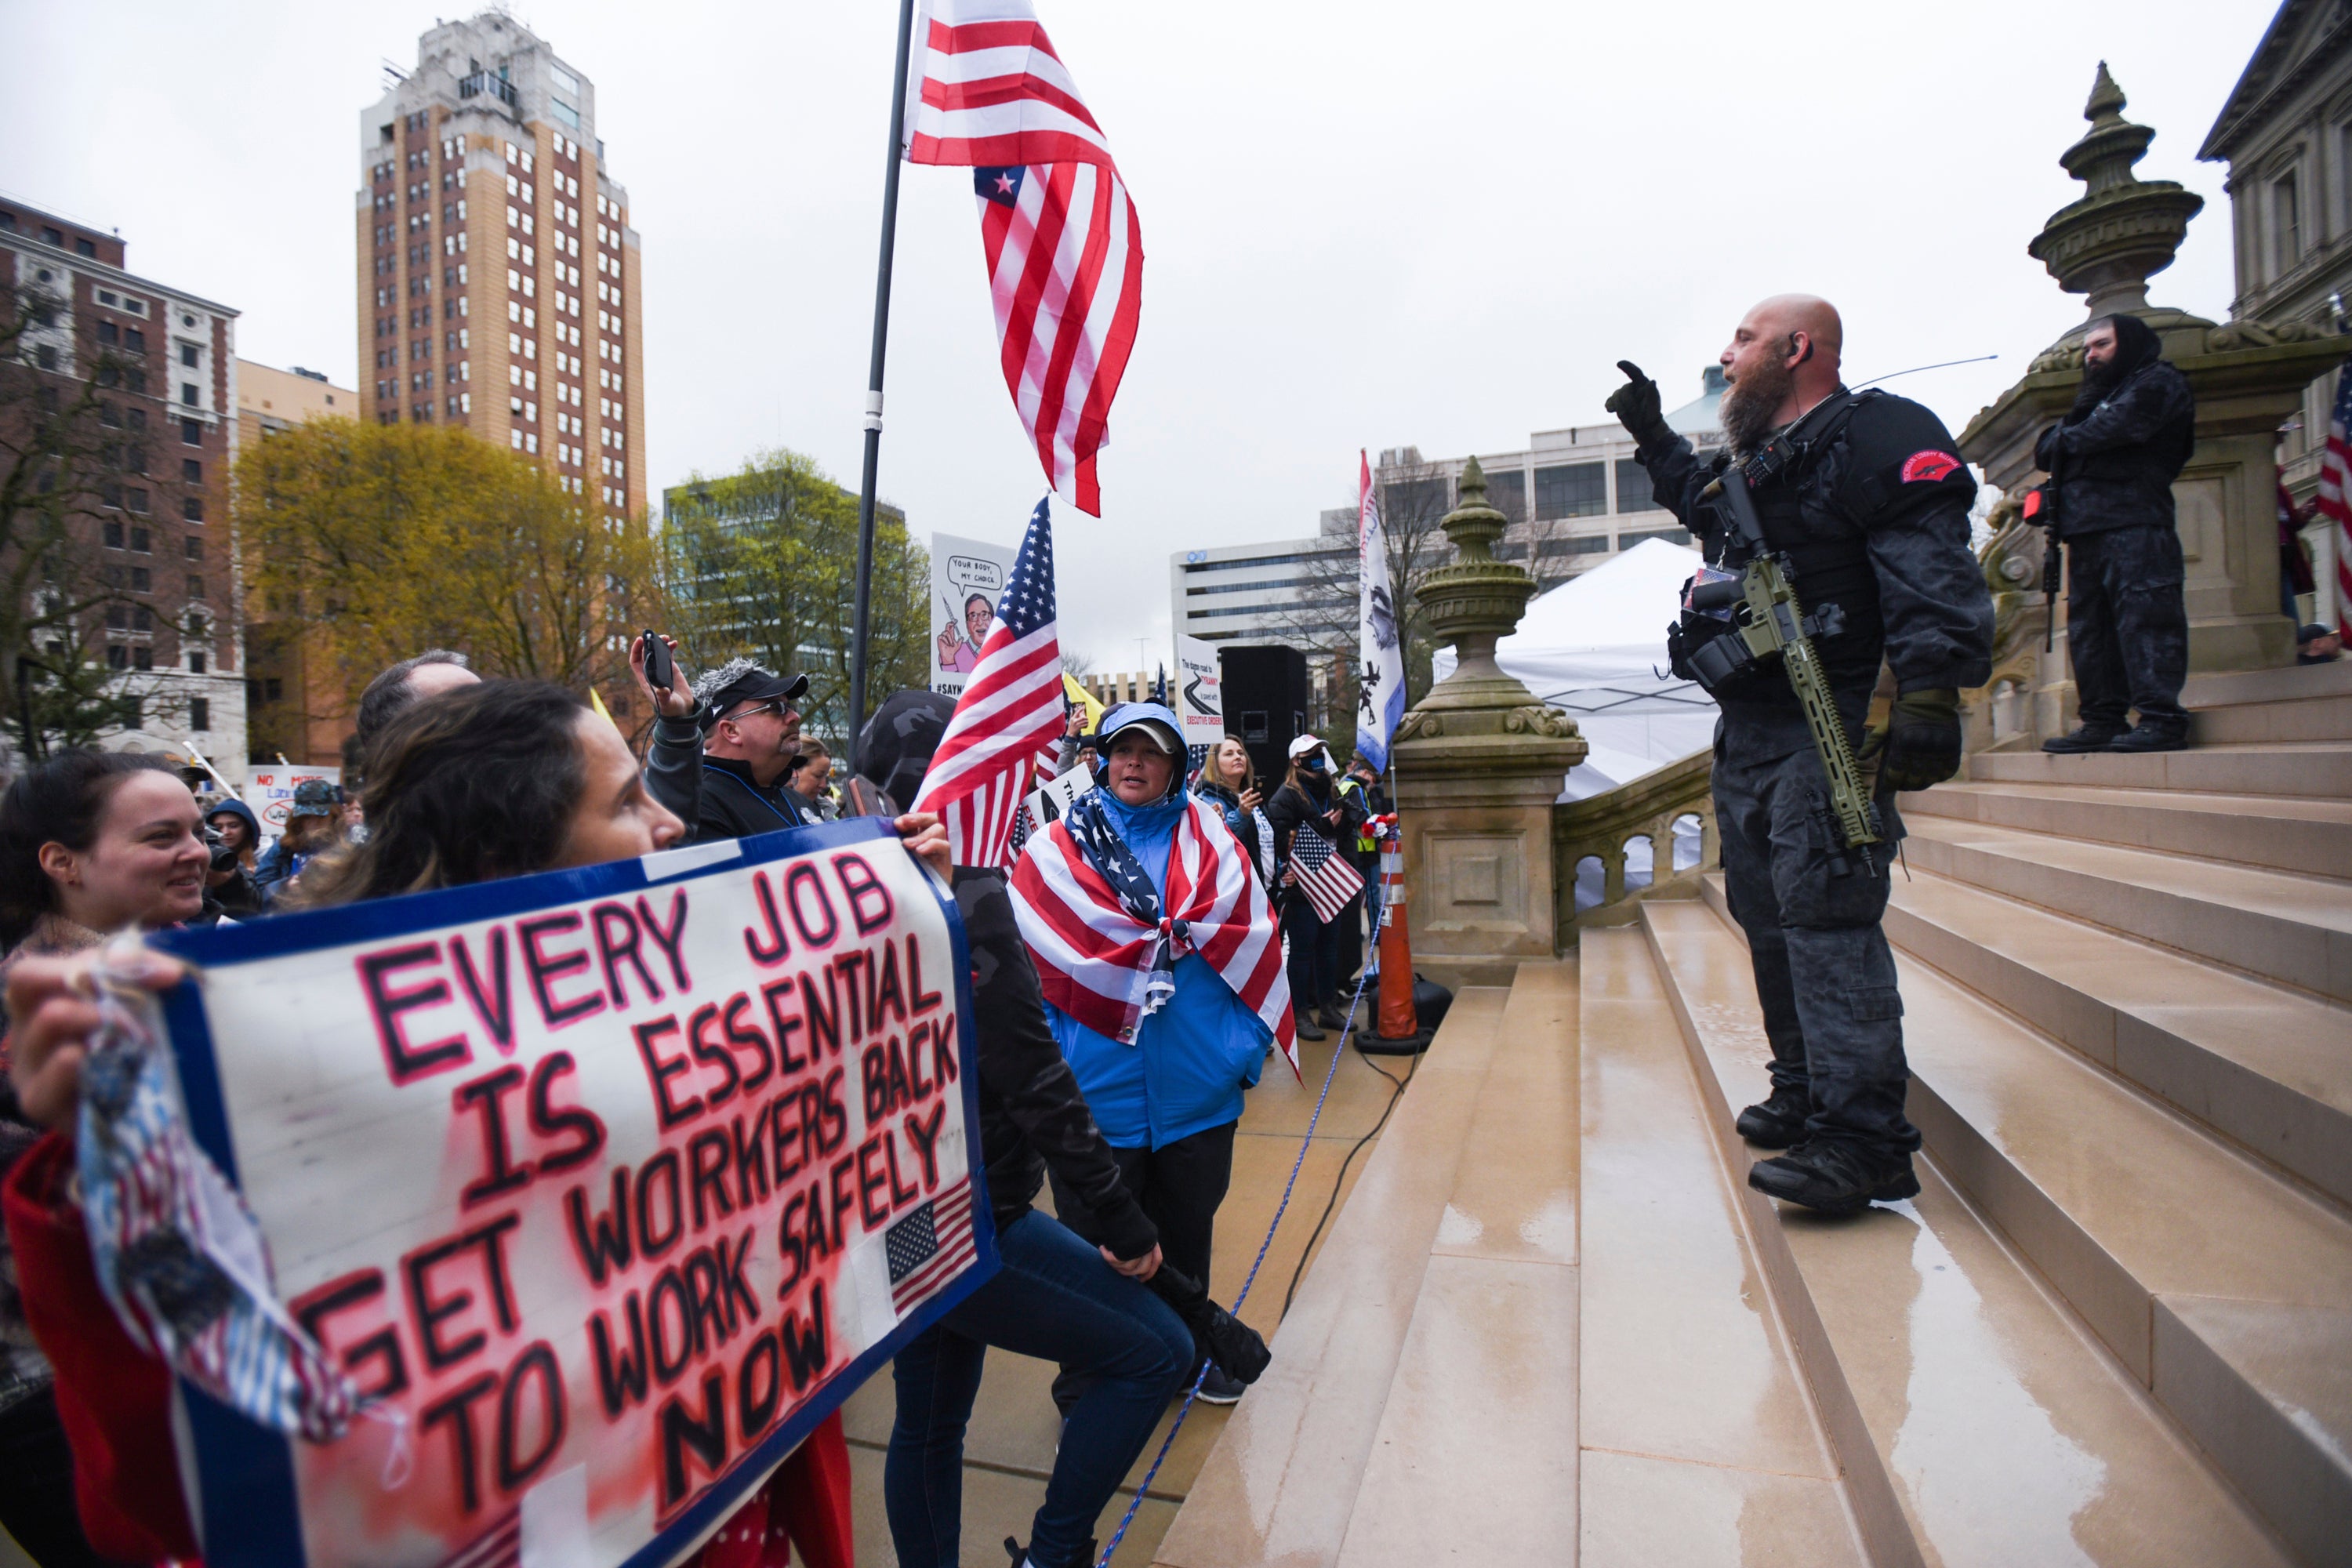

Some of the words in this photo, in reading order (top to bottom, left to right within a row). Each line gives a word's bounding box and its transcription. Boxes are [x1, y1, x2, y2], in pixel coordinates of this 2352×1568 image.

[953, 558, 971, 569] YOUR
[937, 683, 965, 695] #SAYN
[1187, 716, 1207, 725] EXECUTIVE
[1209, 717, 1222, 725] ORDERS
[1201, 676, 1218, 686] TYRANNY
[257, 775, 274, 786] NO
[354, 887, 691, 1087] EVERY
[743, 851, 895, 968] JOB
[452, 1050, 608, 1212] IS
[631, 933, 942, 1134] ESSENTIAL
[289, 1213, 523, 1402] GET
[563, 1064, 849, 1290] WORKERS
[862, 1011, 959, 1131] BACK
[419, 1340, 568, 1517] TO
[586, 1225, 762, 1424] WORK
[777, 1099, 947, 1303] SAFELY
[654, 1278, 832, 1523] NOW
